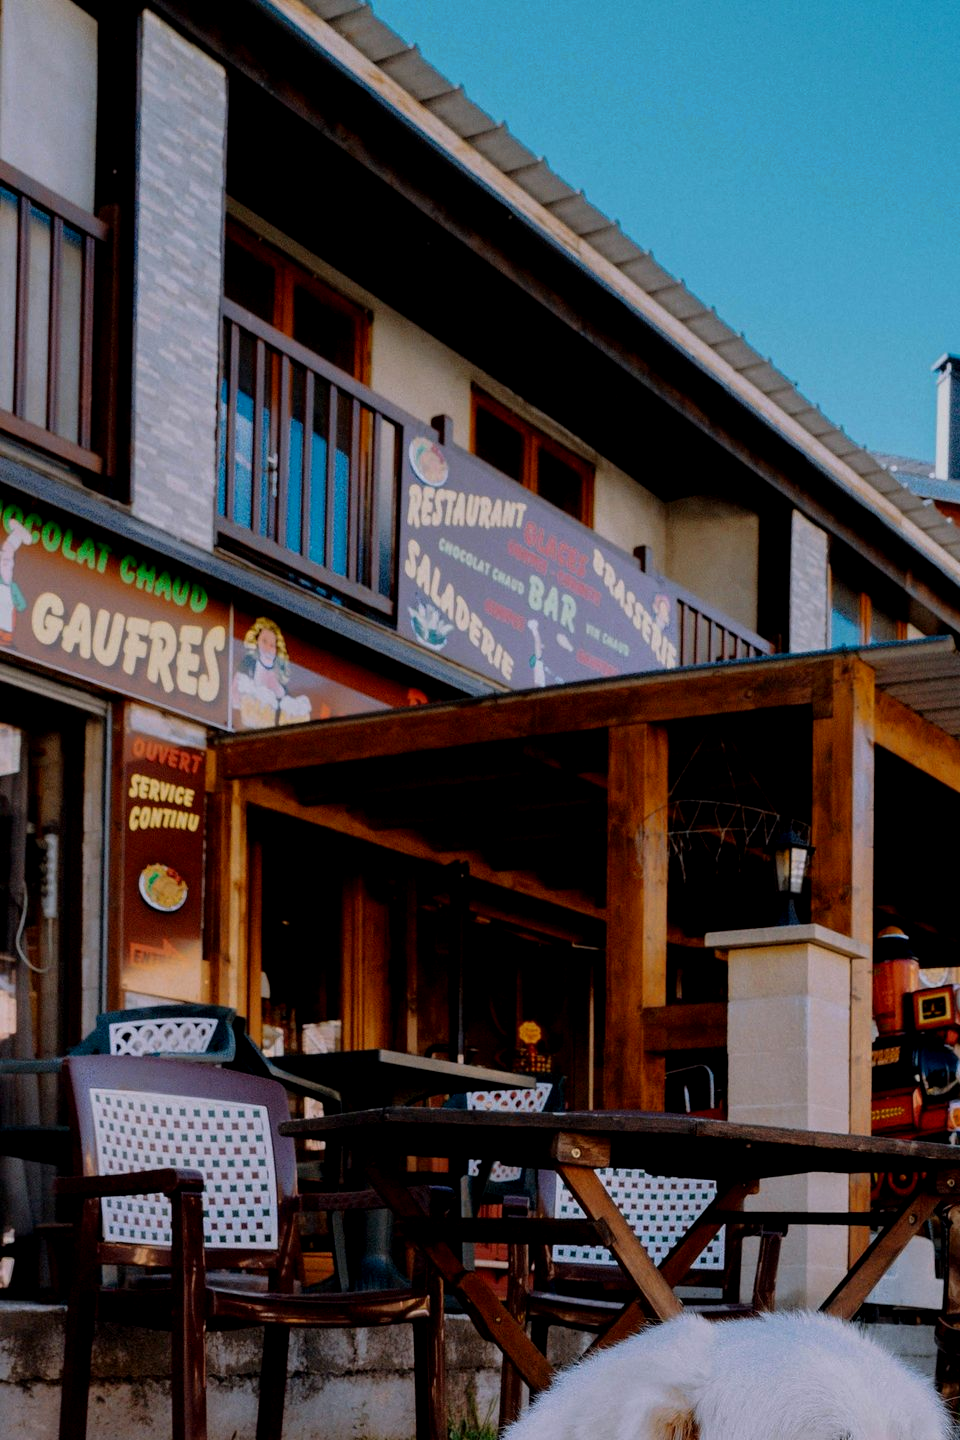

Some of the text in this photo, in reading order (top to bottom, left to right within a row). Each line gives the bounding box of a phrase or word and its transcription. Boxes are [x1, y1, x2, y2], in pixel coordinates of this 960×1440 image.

[407, 484, 527, 529] RESTAURANT
[0, 499, 208, 613] OCOLAT CHAUD
[437, 538, 491, 576] CHOCOLAT
[492, 567, 525, 595] CHAUD
[523, 520, 589, 577] GLACES
[404, 539, 515, 681] SALADERIE
[528, 574, 578, 633] BAR
[592, 547, 677, 669] BRASSERIE
[31, 591, 226, 703] GAUFRES
[132, 737, 203, 774] OUVERT
[128, 773, 195, 808] SERVICE
[128, 806, 200, 833] CONTINU
